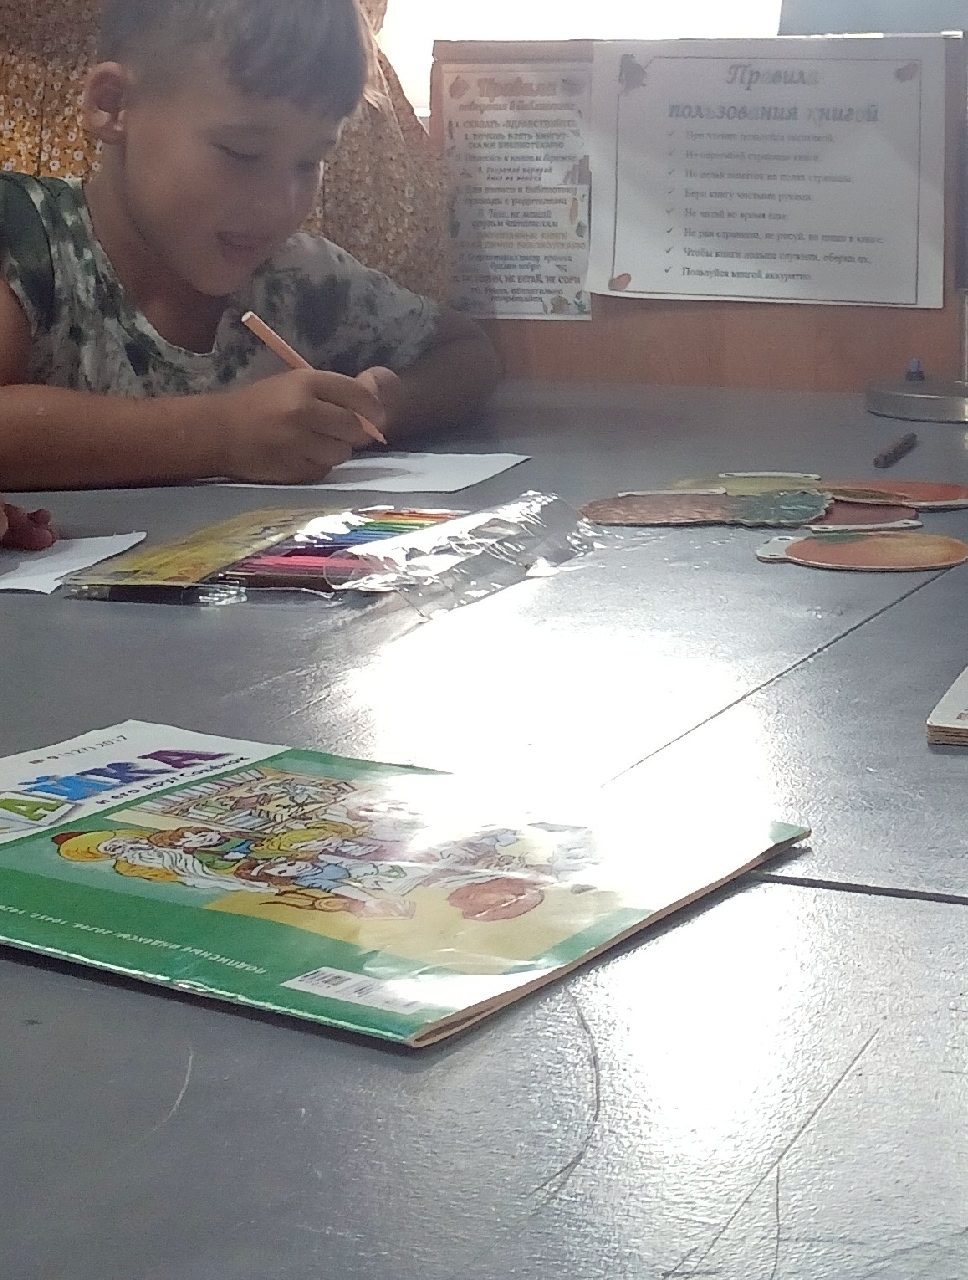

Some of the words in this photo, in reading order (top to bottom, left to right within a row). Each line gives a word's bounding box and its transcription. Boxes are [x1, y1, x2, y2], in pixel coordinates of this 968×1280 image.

[684, 247, 713, 258] Чтобы
[111, 789, 140, 801] его
[143, 775, 179, 790] друг
